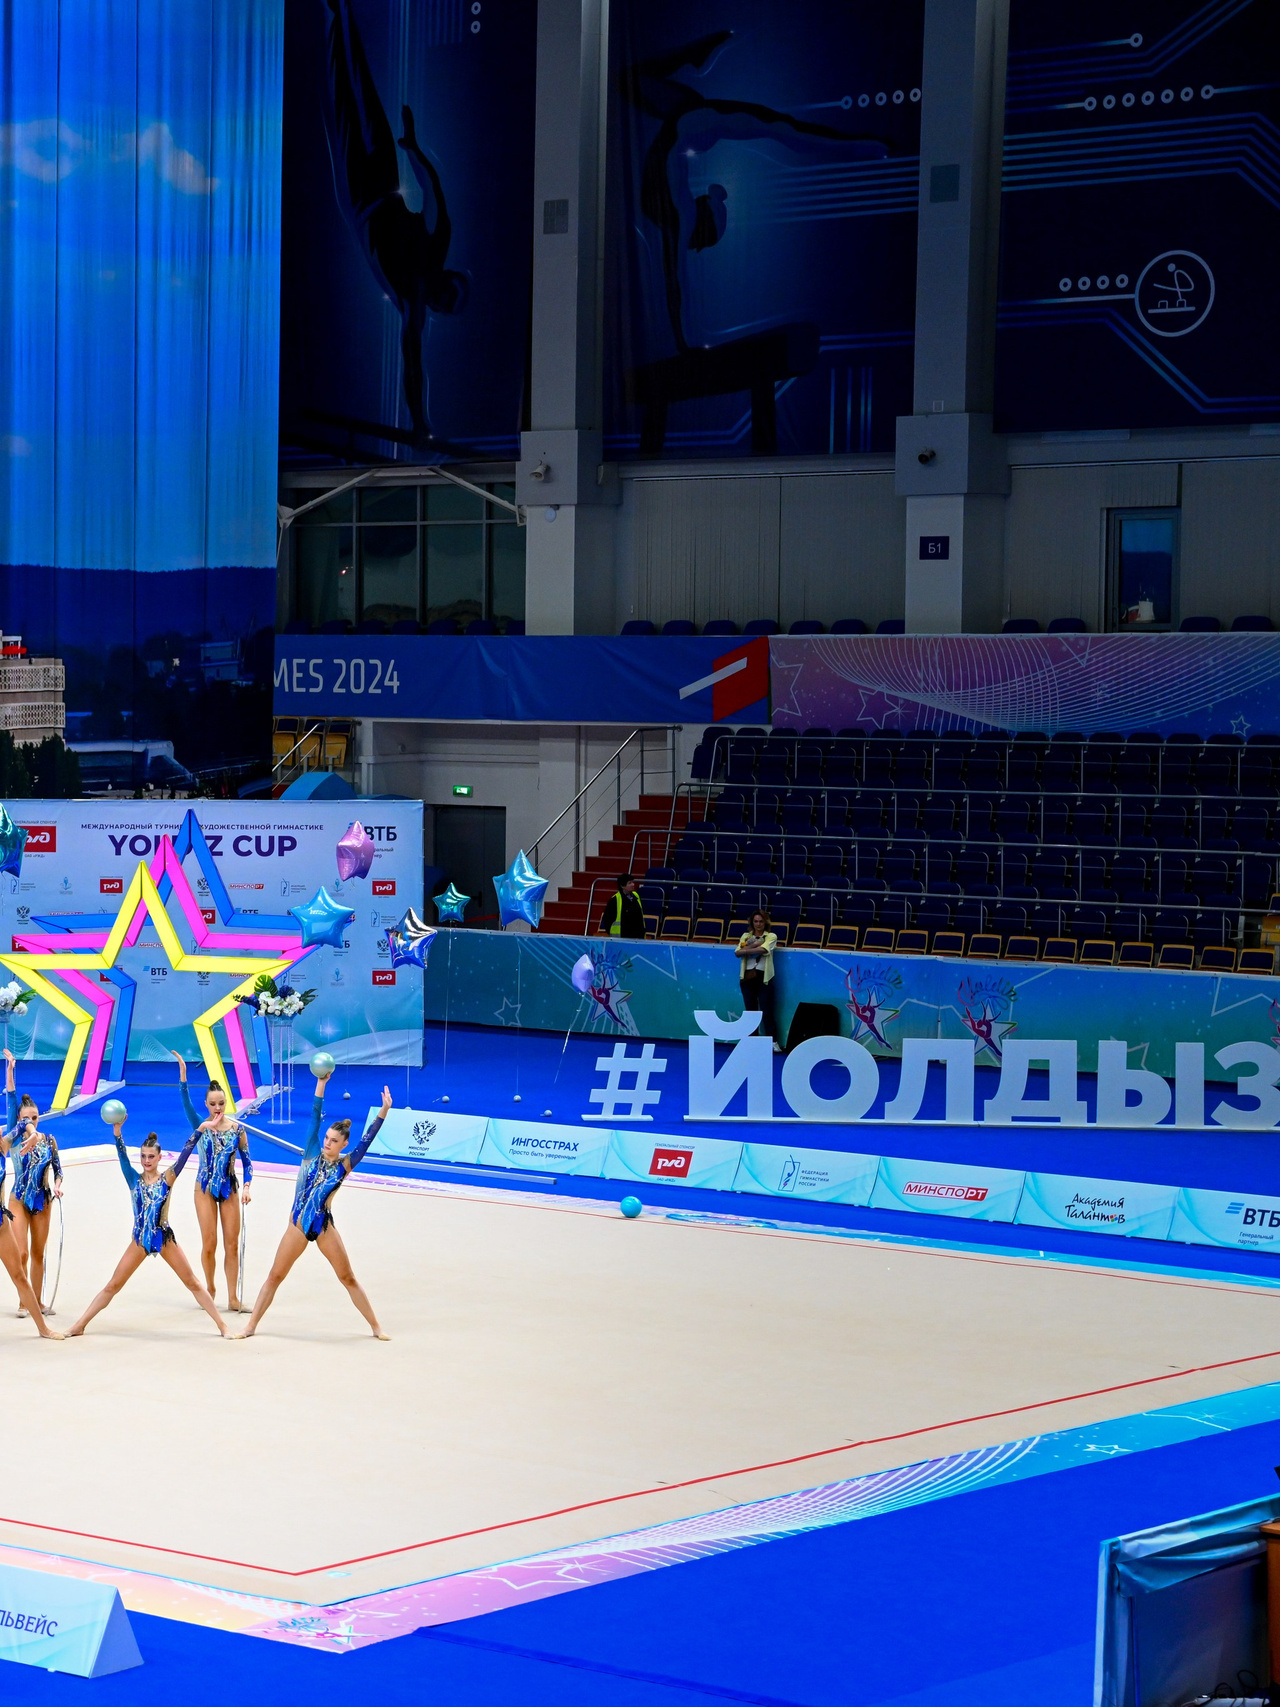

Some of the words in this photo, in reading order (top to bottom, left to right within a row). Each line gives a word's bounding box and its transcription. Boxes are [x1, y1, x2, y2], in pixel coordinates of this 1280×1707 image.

[928, 543, 941, 553] Б1
[332, 658, 400, 694] 2024
[232, 835, 297, 857] CUP
[151, 967, 168, 976] ВТБ
[510, 1136, 580, 1152] ИНГОССТРАХ
[508, 1148, 529, 1157] Просто
[530, 1149, 544, 1158] быть
[905, 1182, 988, 1201] МИНСПОРТ
[1242, 1207, 1280, 1228] ВТБ
